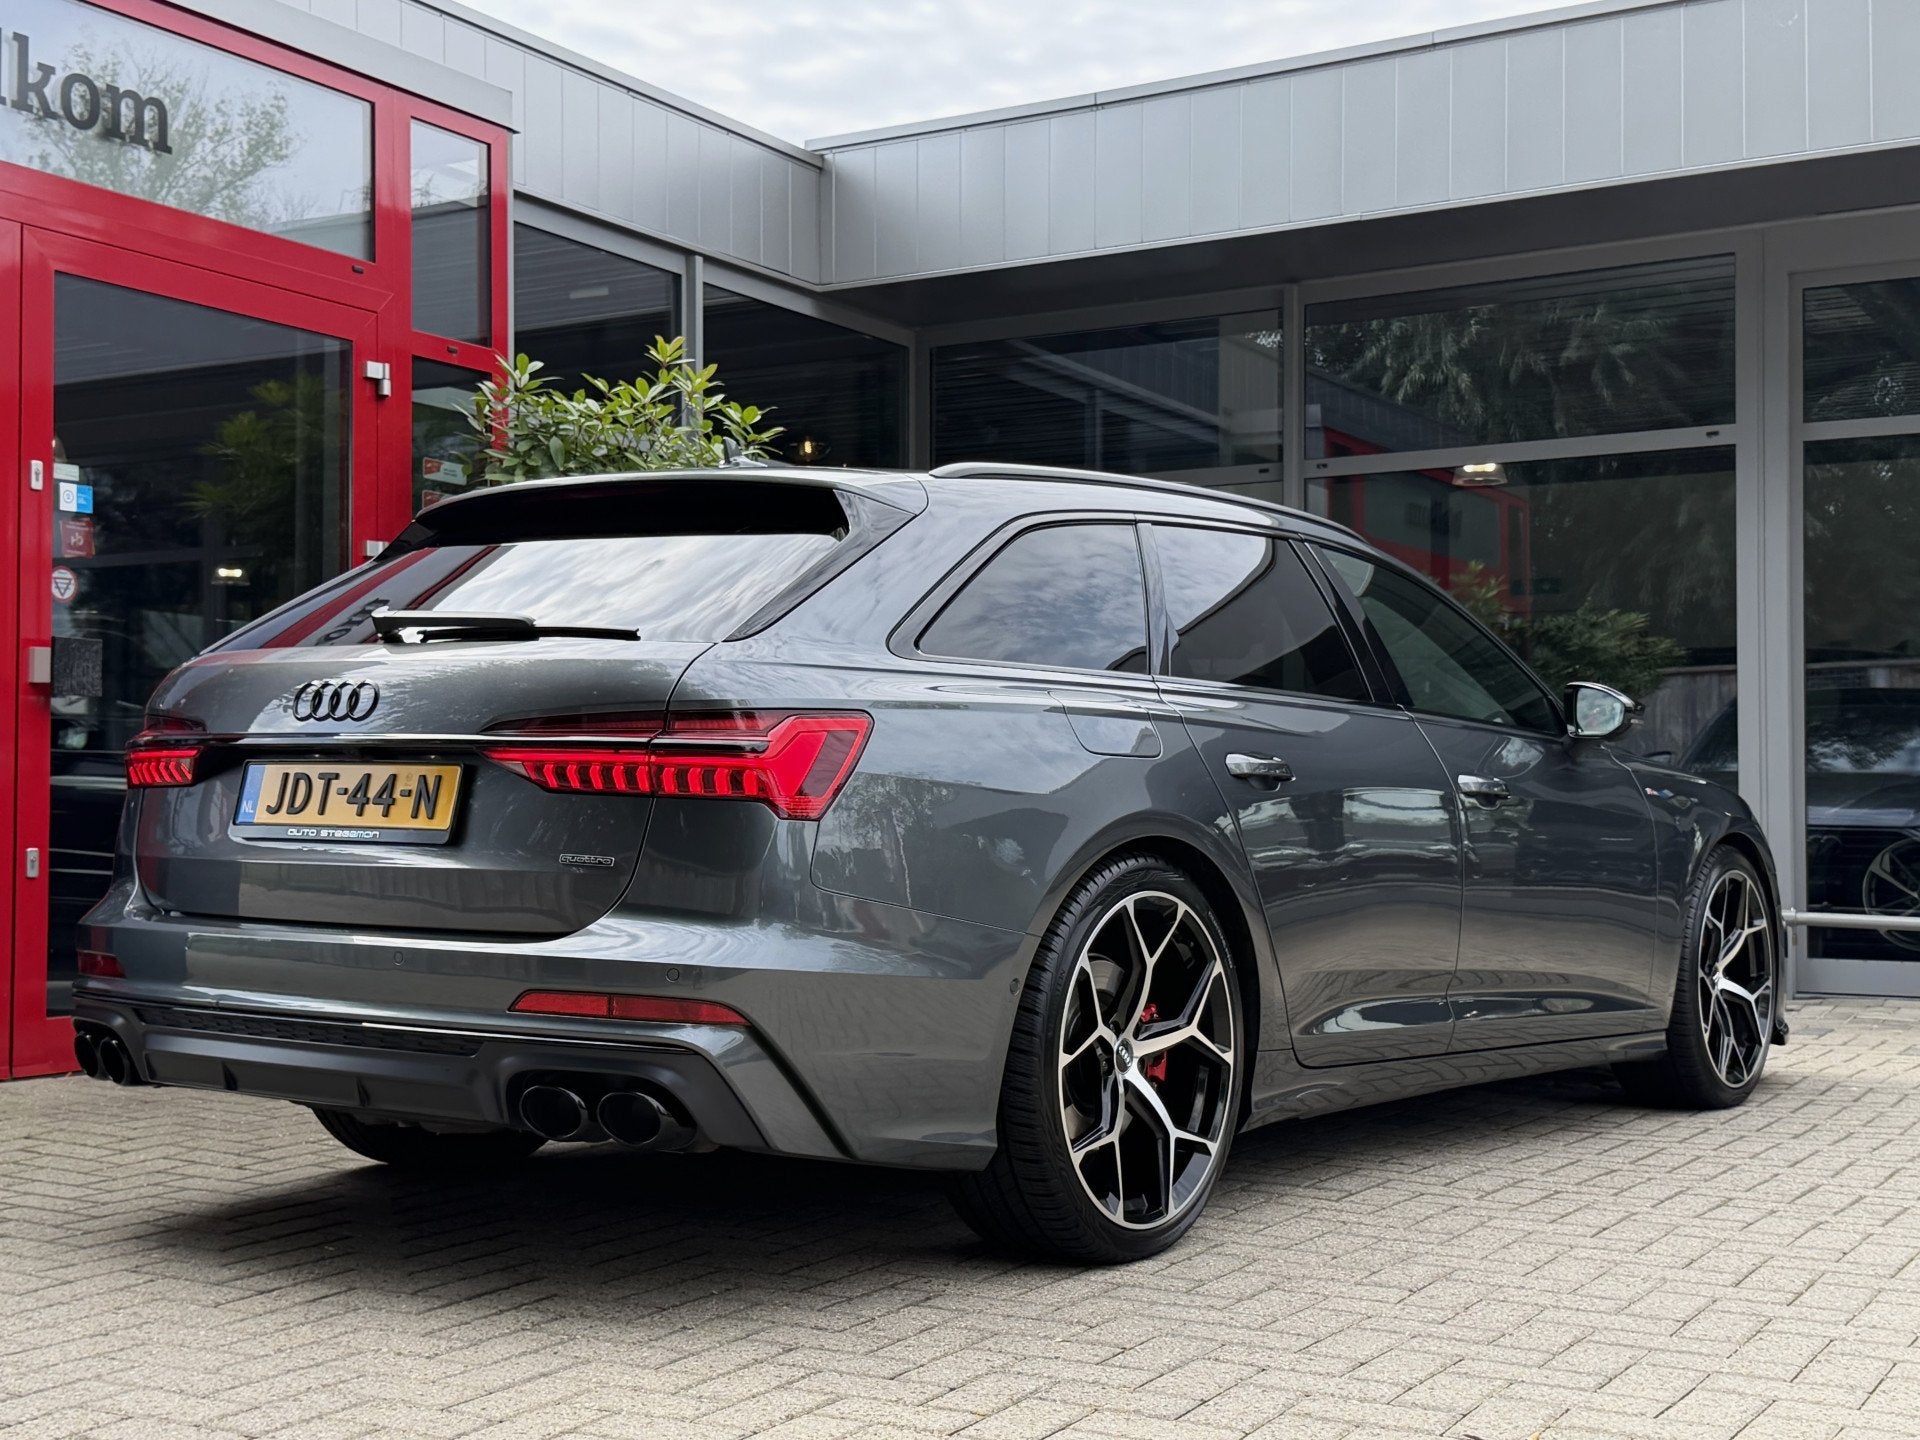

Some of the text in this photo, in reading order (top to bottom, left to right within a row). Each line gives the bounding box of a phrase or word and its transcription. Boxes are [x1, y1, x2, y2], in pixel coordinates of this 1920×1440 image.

[0, 27, 172, 155] kom
[241, 800, 254, 813] NL
[266, 772, 442, 819] JDT-44-N
[561, 855, 611, 865] quattro
